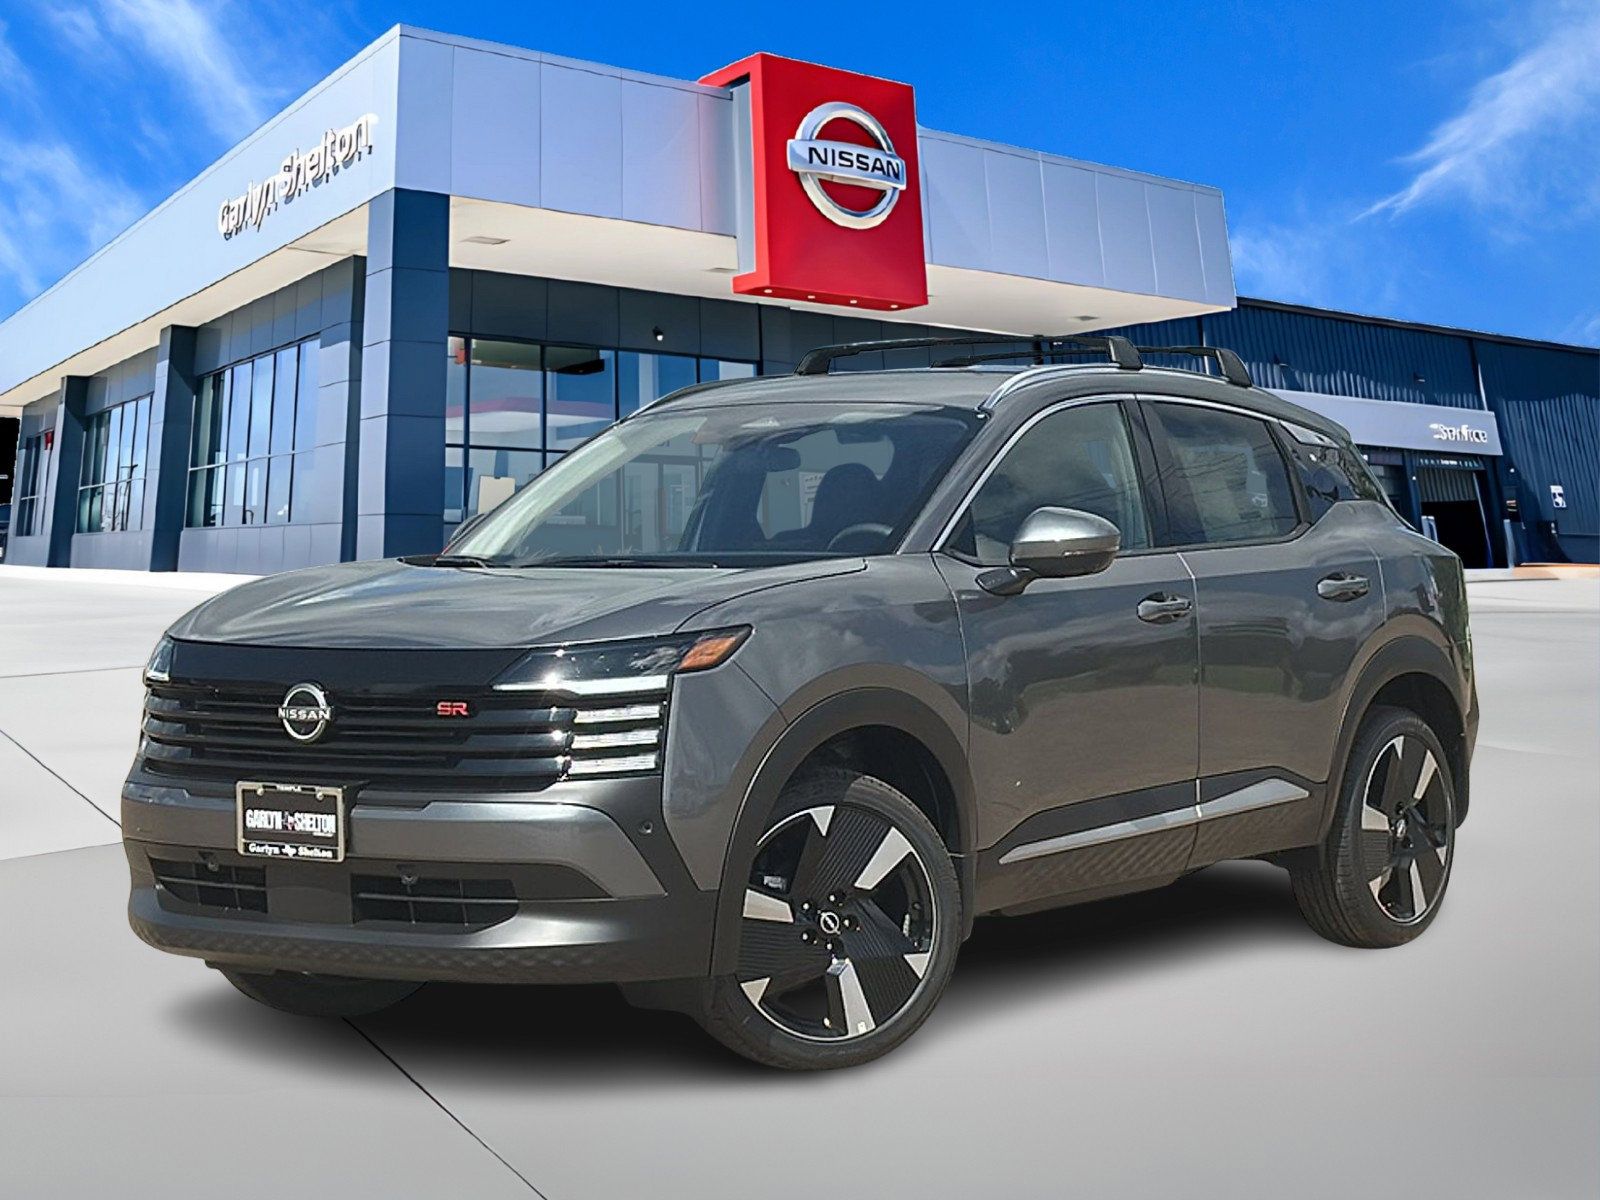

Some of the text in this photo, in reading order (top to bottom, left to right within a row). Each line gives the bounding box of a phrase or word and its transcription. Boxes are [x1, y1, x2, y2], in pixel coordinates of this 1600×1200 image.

[808, 146, 900, 181] NISSAN
[218, 115, 376, 237] Garlyn Shelton
[278, 706, 330, 721] NISSAN
[437, 701, 469, 716] SR
[294, 811, 336, 834] SHELTON
[248, 842, 333, 858] Garlyn Shelton
